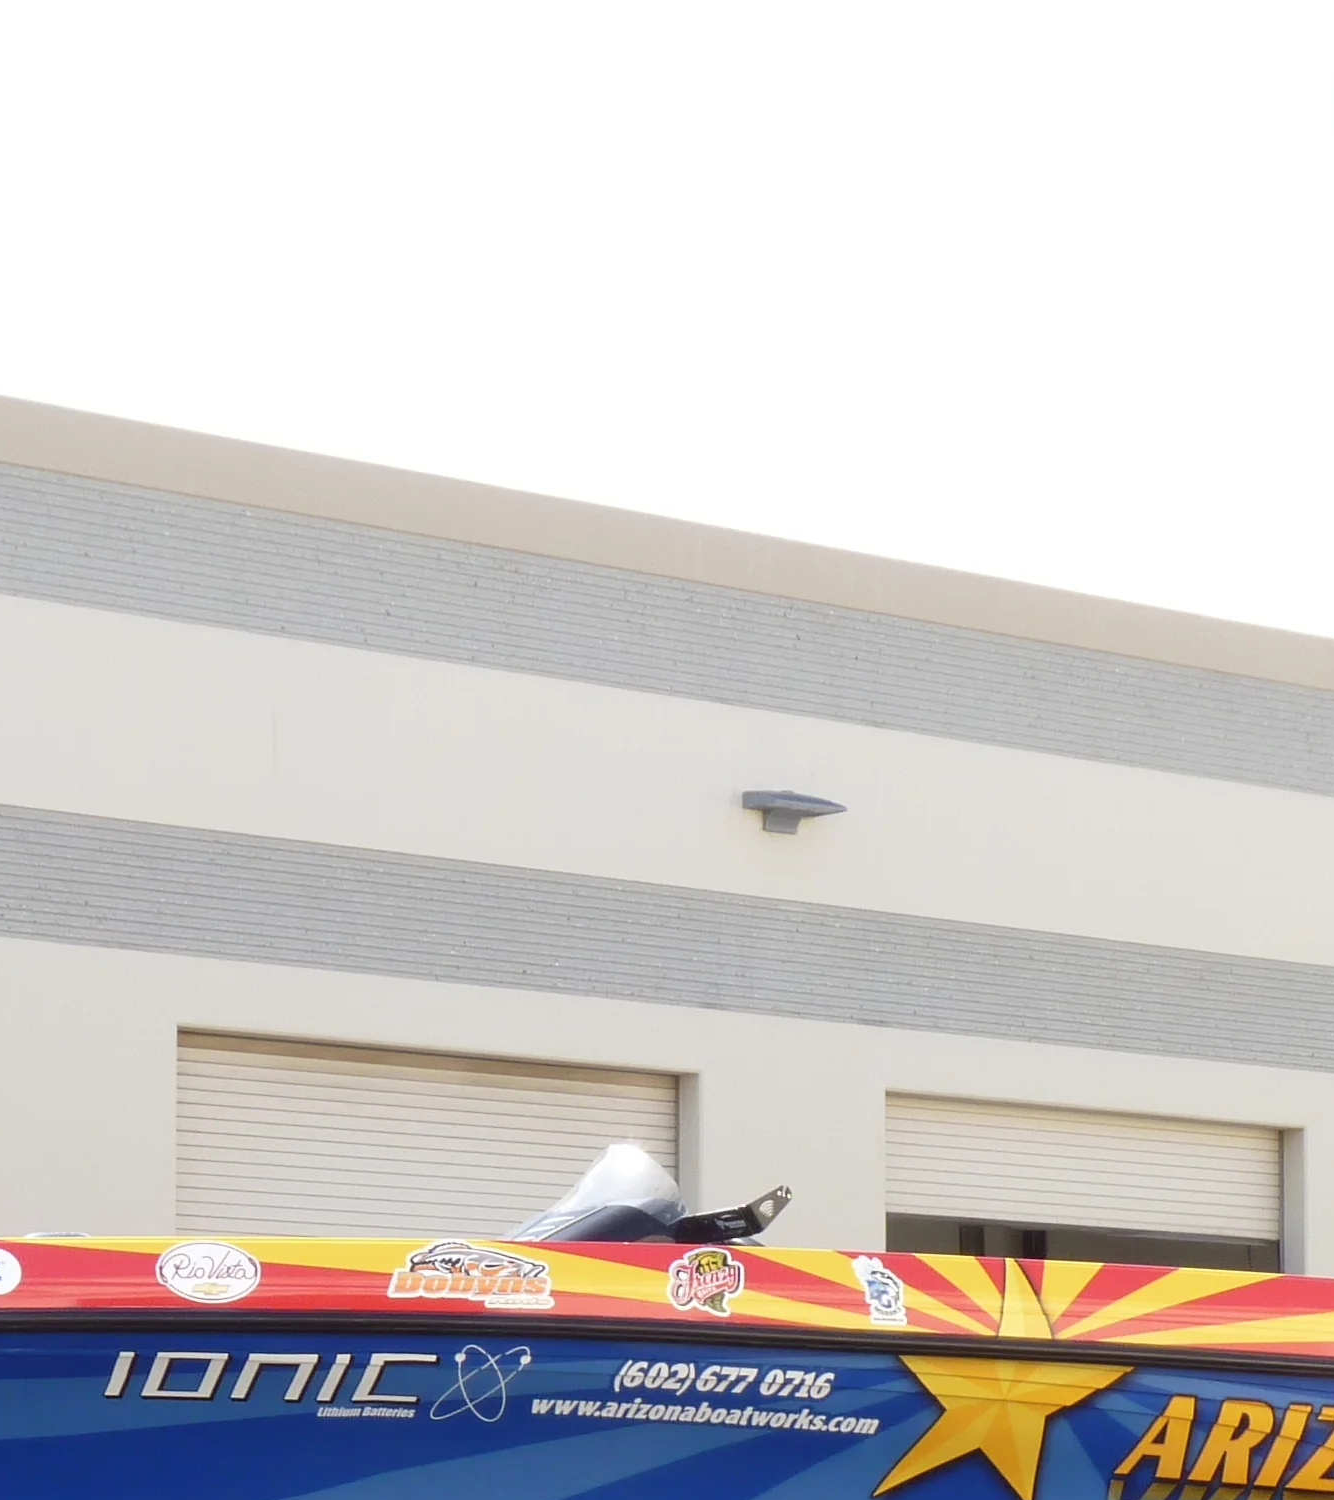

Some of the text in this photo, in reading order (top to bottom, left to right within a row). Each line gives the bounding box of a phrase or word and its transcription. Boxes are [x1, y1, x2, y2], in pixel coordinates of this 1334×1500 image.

[161, 1250, 255, 1280] Rio Vista
[393, 1271, 548, 1297] Dobyns
[614, 1359, 836, 1400] (602) 677 0716
[317, 1406, 416, 1418] Lithium Batteries
[531, 1397, 880, 1435] www.arizonaboatworks.com
